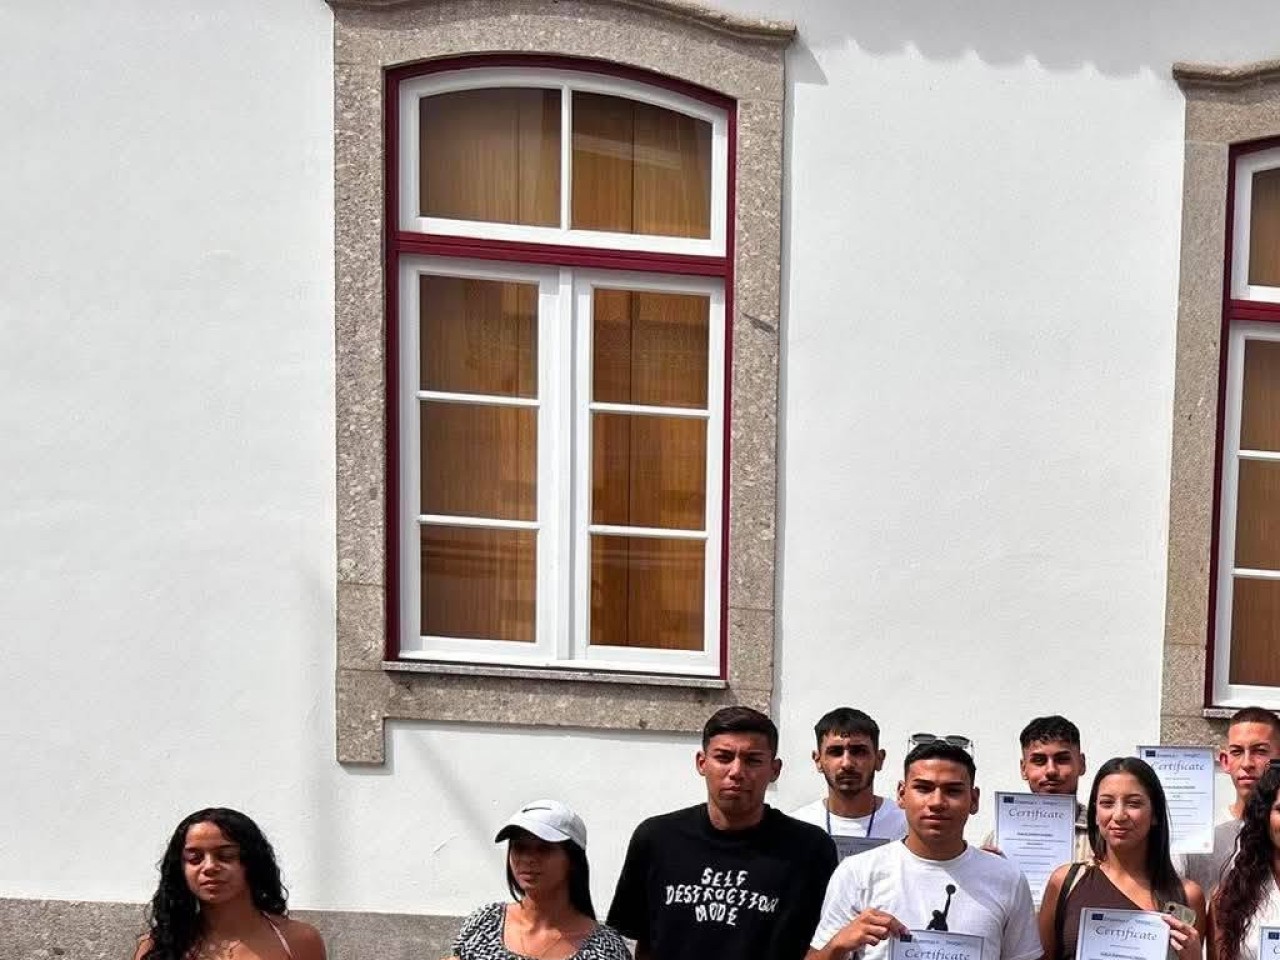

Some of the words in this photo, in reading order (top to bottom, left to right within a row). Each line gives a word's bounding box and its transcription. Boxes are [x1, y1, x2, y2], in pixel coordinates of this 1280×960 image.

[1008, 808, 1065, 820] Certificate
[701, 867, 748, 886] SELF
[695, 902, 738, 925] MODE
[1094, 925, 1157, 940] Certificate
